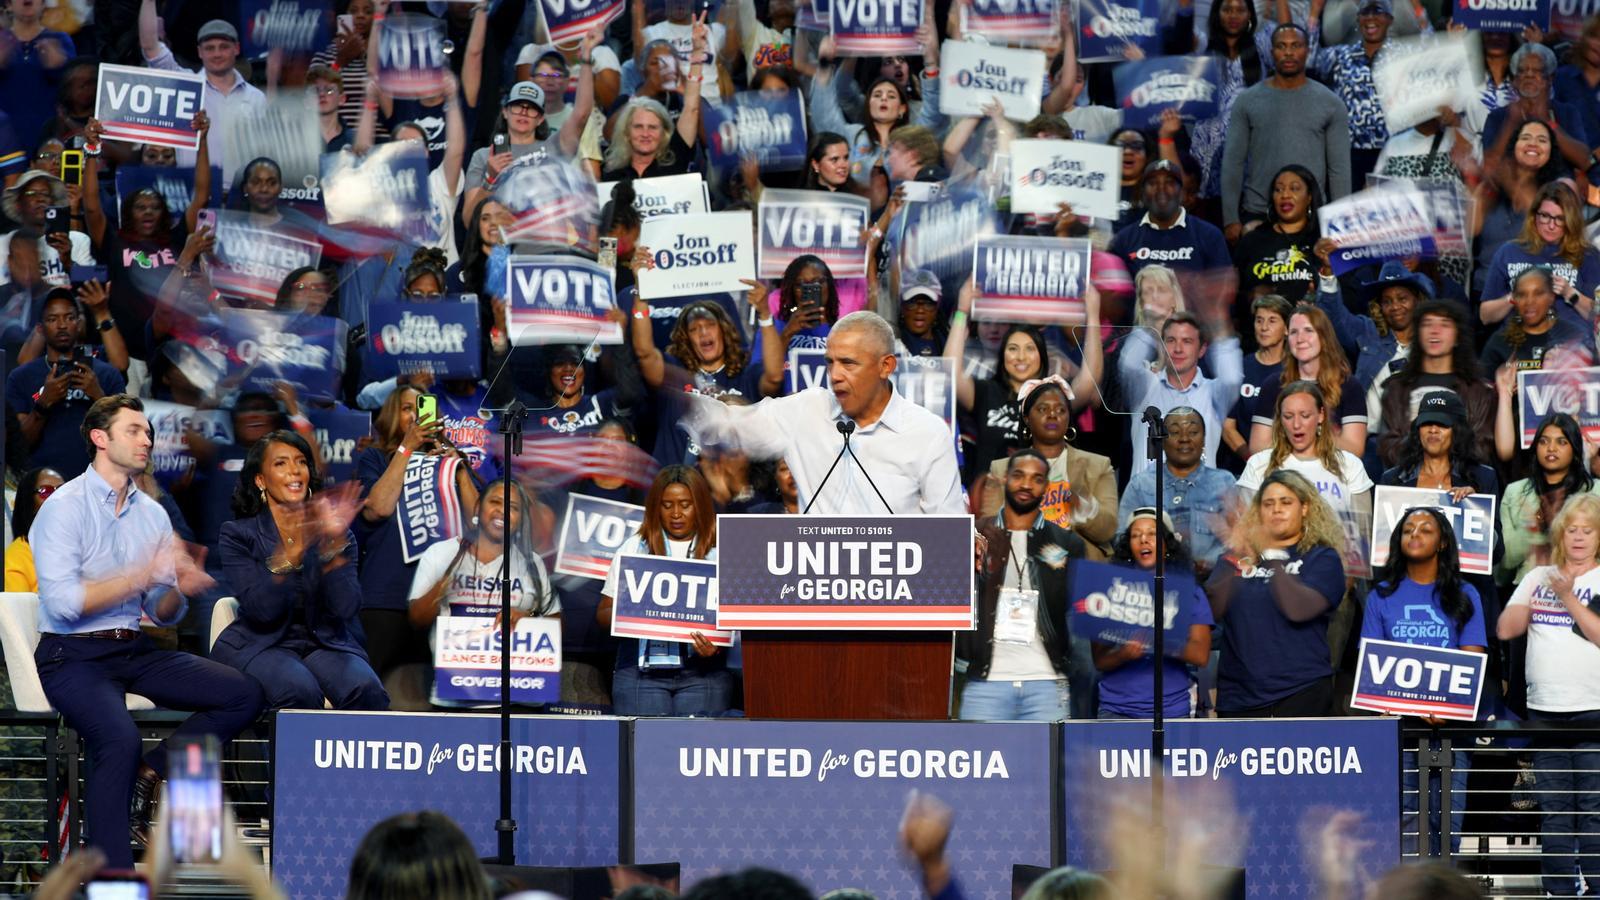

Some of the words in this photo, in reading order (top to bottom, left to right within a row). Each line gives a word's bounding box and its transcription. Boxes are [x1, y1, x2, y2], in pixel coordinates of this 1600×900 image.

[975, 60, 1006, 77] Jon
[958, 69, 1028, 95] Ossoff
[106, 81, 196, 120] VOTE
[1049, 154, 1082, 171] Jon
[1031, 168, 1105, 191] Ossoff
[634, 194, 667, 209] Jon
[766, 207, 862, 248] VOTE
[674, 234, 709, 250] Jon
[1136, 247, 1194, 260] Ossoff
[655, 244, 737, 269] Ossoff
[986, 248, 1080, 276] UNITED
[515, 268, 612, 310] VOTE
[1525, 384, 1600, 416] VOT
[443, 416, 480, 429] eisha
[320, 439, 355, 463] off
[404, 454, 428, 546] UNITED
[576, 510, 643, 548] VOT
[798, 527, 819, 535] TEXT
[821, 527, 853, 535] UNITED
[855, 527, 866, 535] TO
[868, 527, 892, 535] 51015
[1384, 502, 1485, 541] VTE
[767, 541, 923, 575] UNITED
[780, 584, 795, 599] for
[797, 579, 913, 600] GEORGIA
[1108, 579, 1153, 608] Jon
[660, 611, 676, 619] VOTE
[1532, 613, 1574, 625] GOVERNO
[1391, 625, 1449, 639] GEORGIA
[442, 654, 485, 664] LANCE
[1367, 653, 1475, 695] VOTE
[1402, 691, 1417, 699] VOTE
[314, 740, 423, 770] UNITED
[427, 743, 454, 775] for
[679, 748, 812, 777] UNITED
[817, 749, 849, 782] for
[854, 749, 1010, 779] GEORGIA
[1213, 748, 1238, 781] for
[1241, 746, 1363, 775] GEORGIA
